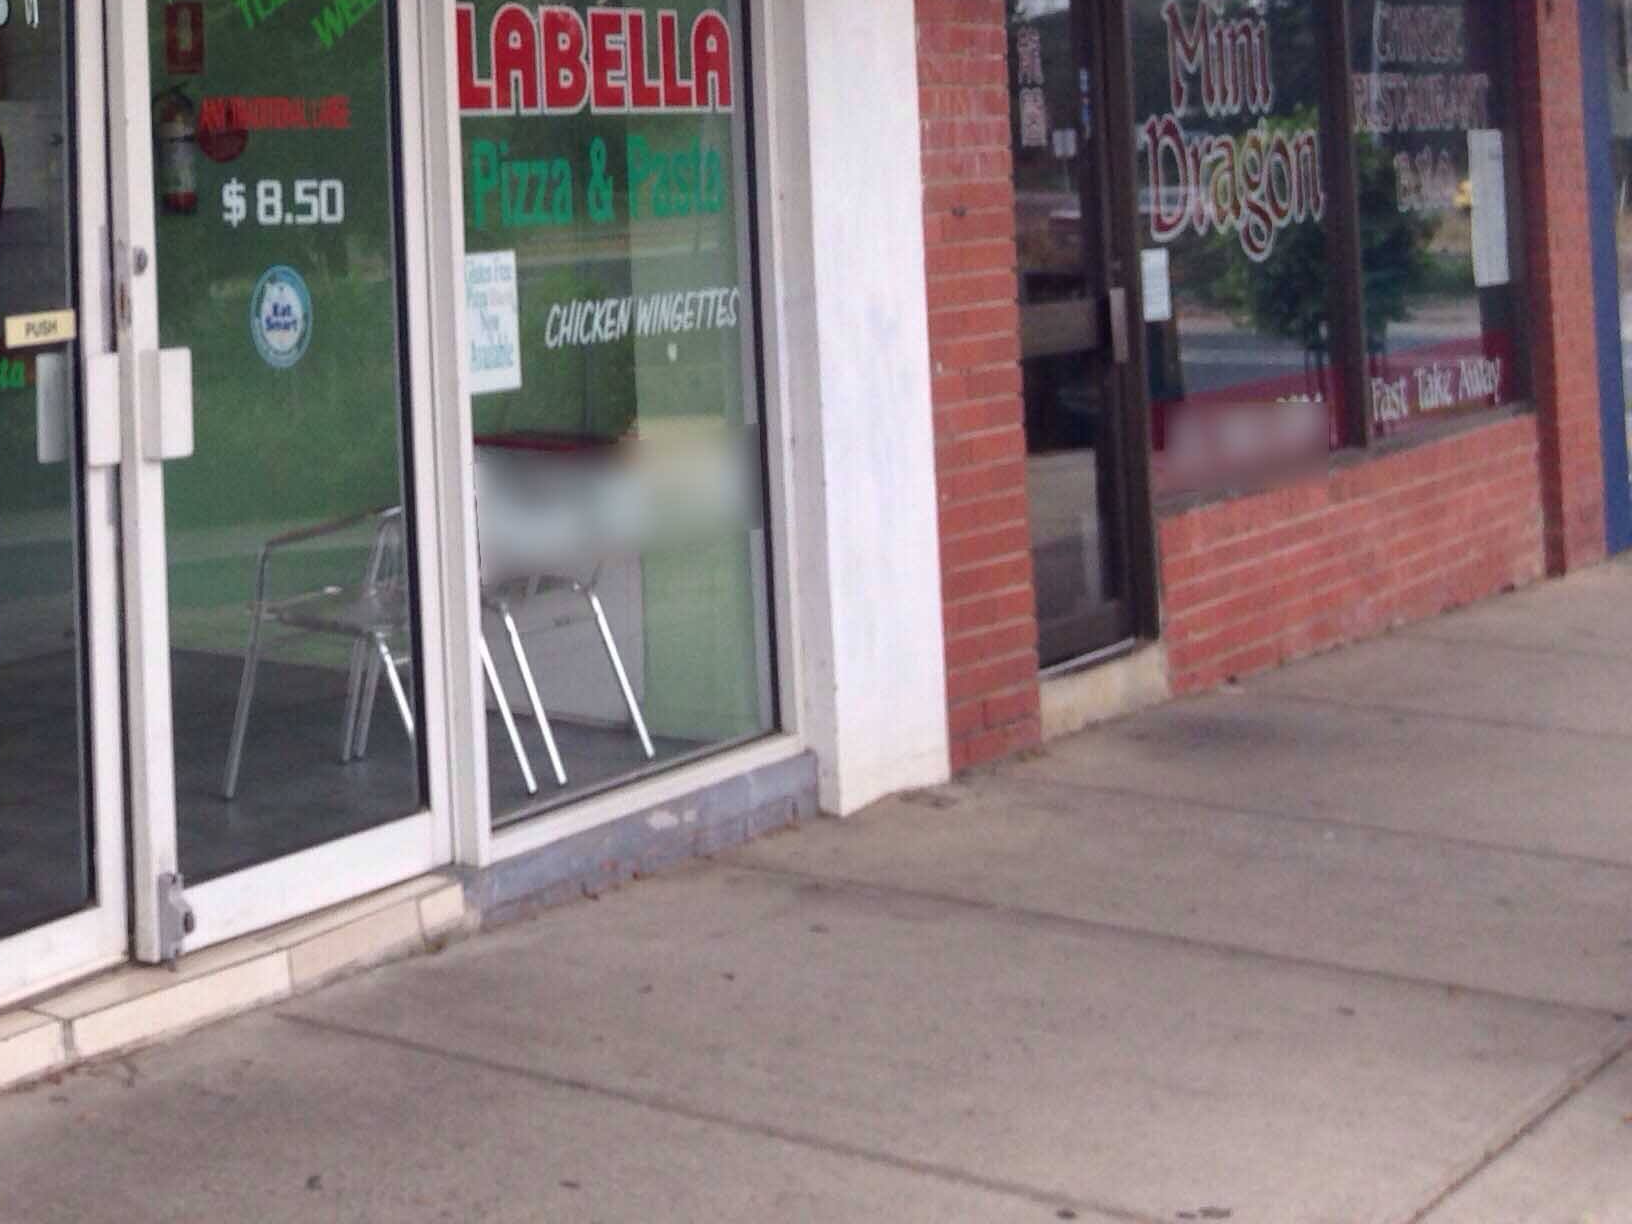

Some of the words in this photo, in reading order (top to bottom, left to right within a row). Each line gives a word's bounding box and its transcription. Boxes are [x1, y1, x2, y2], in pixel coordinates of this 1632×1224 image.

[455, 2, 735, 116] LABELLA
[471, 137, 574, 231] Pizza
[587, 136, 615, 226] &
[625, 134, 726, 222] Pasta
[1142, 106, 1326, 263] Dragon
[24, 318, 59, 339] PUSH
[544, 296, 633, 350] CHICKEN
[636, 286, 740, 337] WINGETTES
